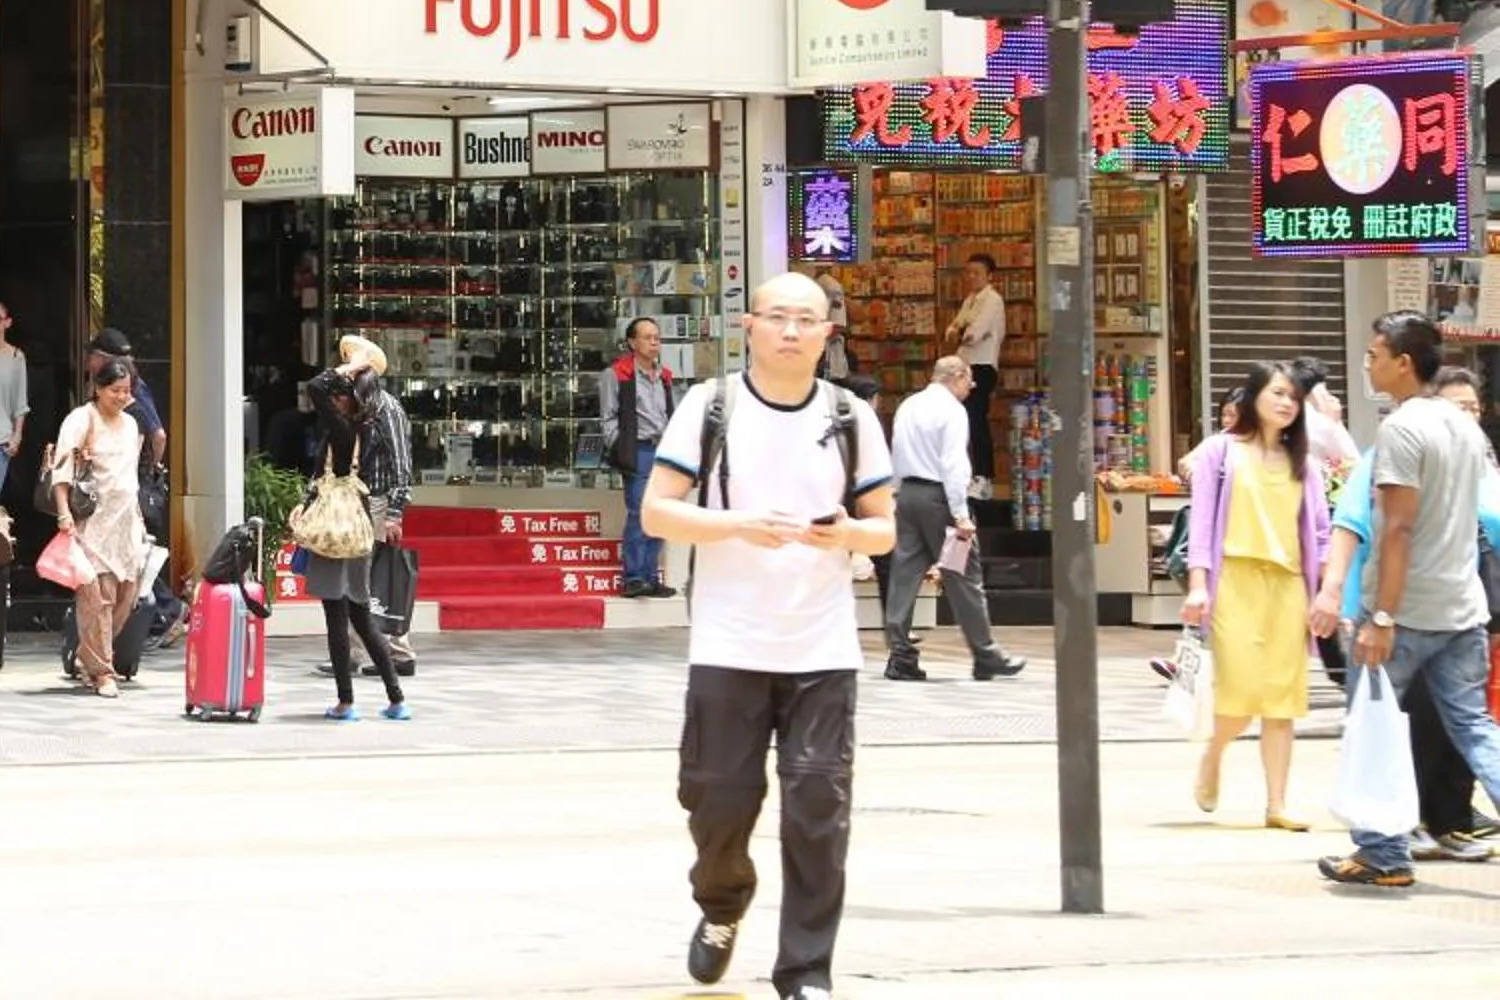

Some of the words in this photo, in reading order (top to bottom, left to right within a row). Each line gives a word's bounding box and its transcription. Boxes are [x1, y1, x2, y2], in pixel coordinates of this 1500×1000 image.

[231, 106, 315, 139] Canon
[364, 135, 442, 158] Canon
[500, 515, 517, 533] 免
[522, 517, 547, 533] Tax
[550, 517, 579, 532] Free
[531, 544, 547, 563] 免
[554, 546, 579, 561] Tax
[581, 546, 610, 561] Free
[563, 573, 579, 592] 免
[586, 575, 609, 591] Tax
